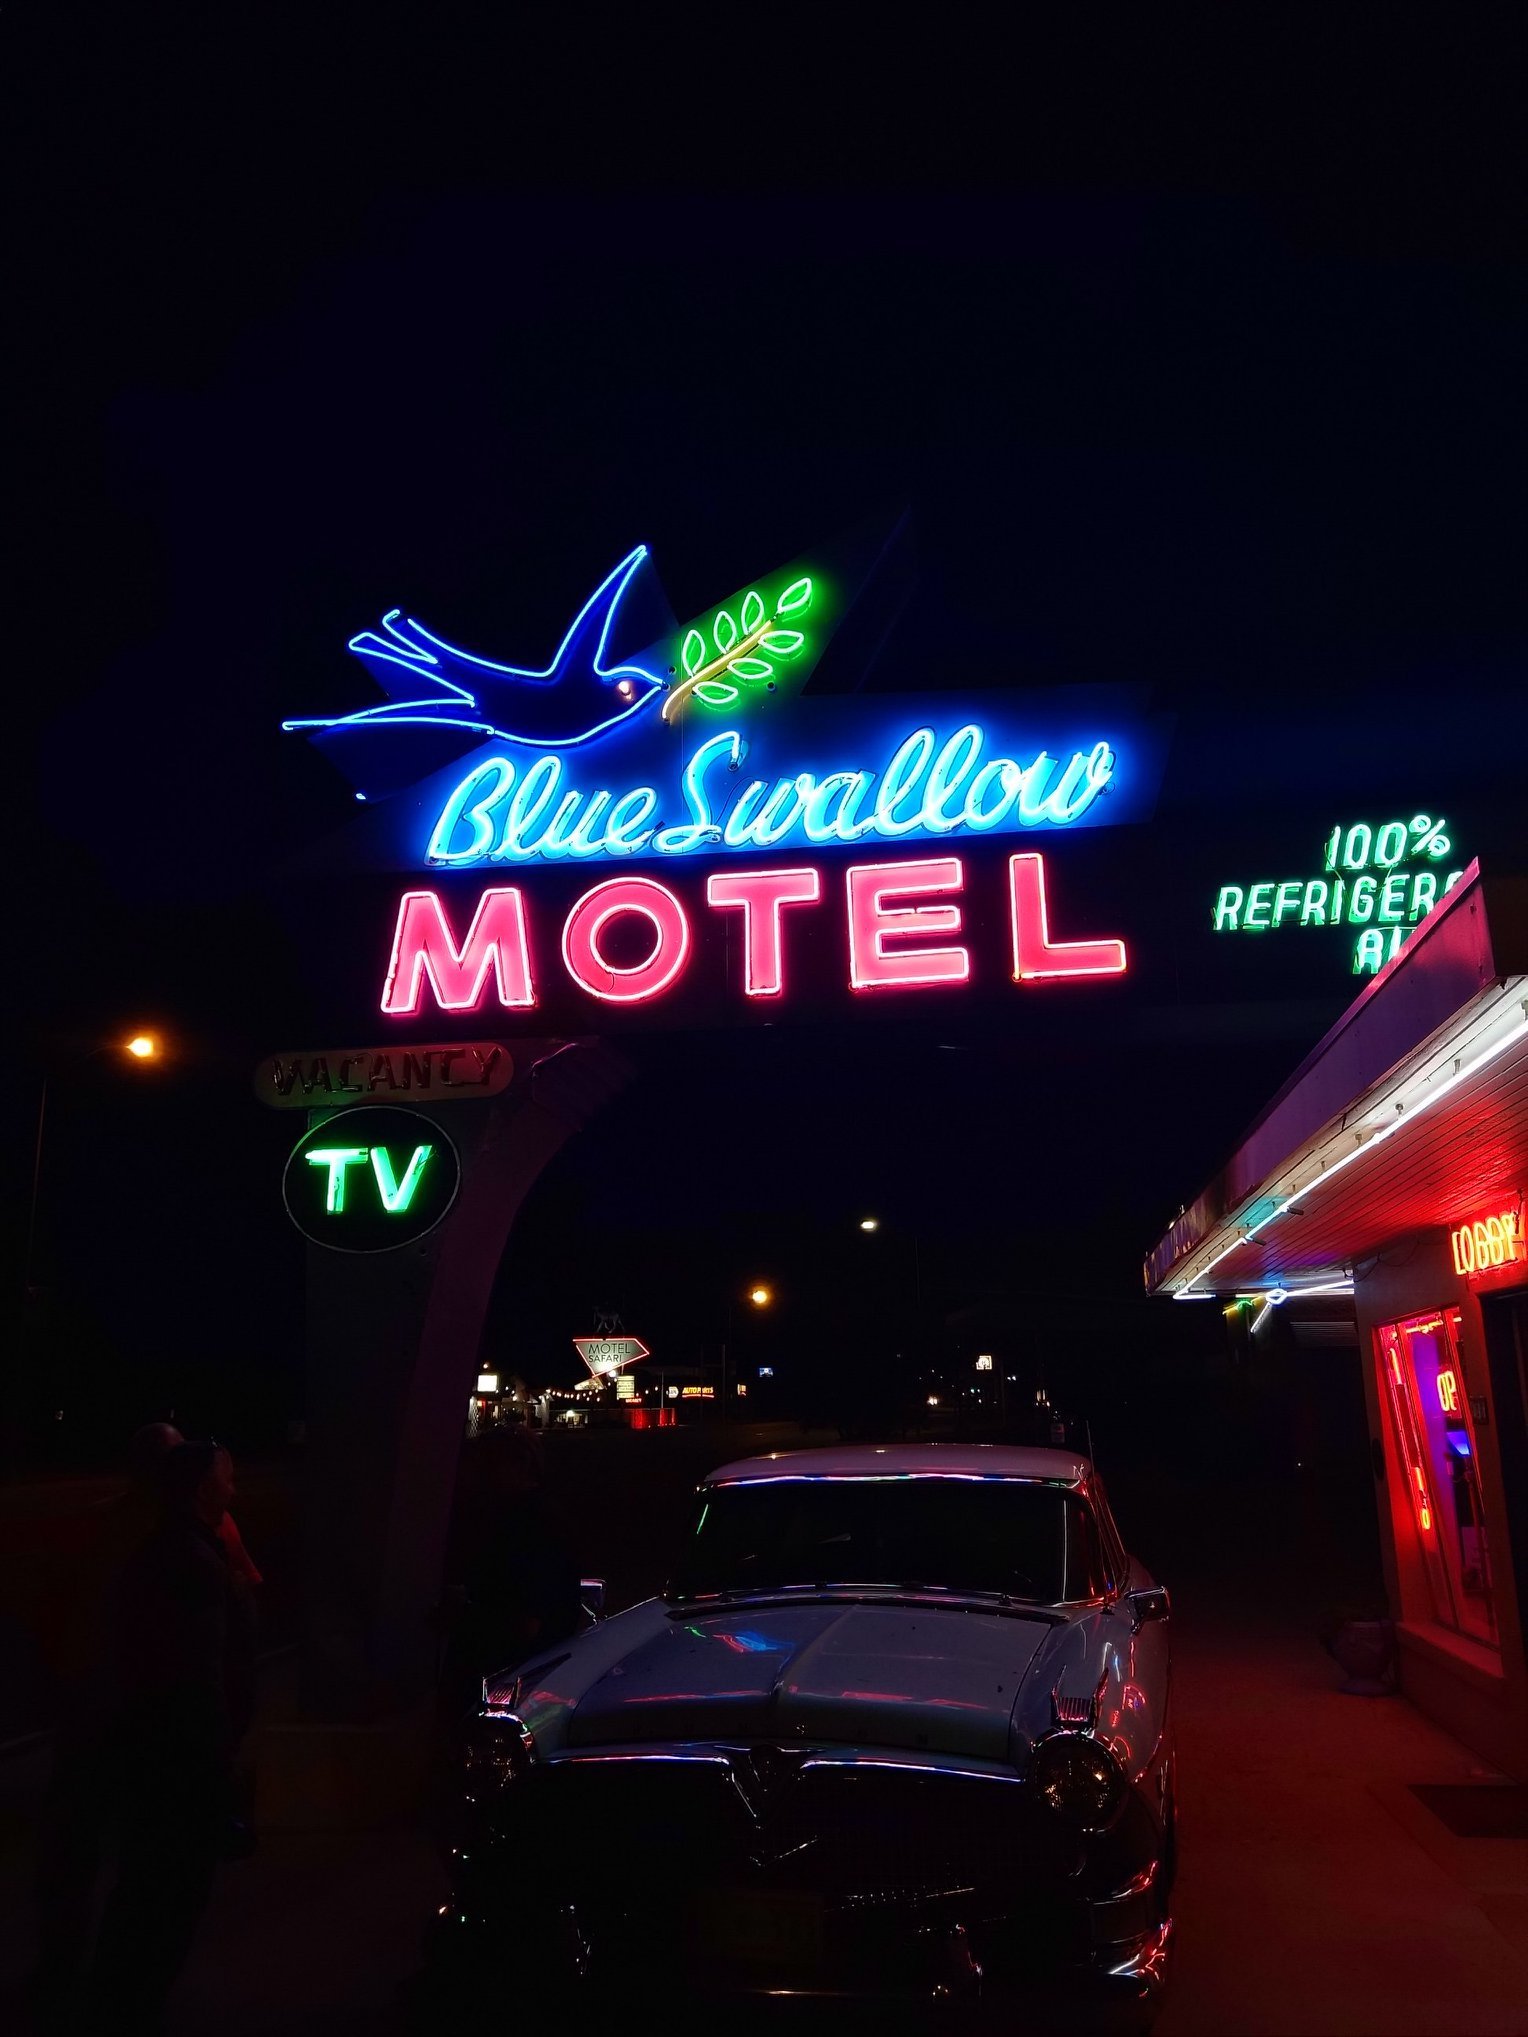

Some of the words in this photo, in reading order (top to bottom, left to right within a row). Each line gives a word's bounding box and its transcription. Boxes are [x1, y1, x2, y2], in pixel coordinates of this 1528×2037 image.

[425, 755, 657, 867] Blue
[653, 723, 1114, 856] Swallow
[1325, 813, 1452, 871] 100%
[380, 853, 1127, 1014] MOTEL
[272, 1045, 503, 1096] VACANCY
[304, 1145, 434, 1215] TV
[1451, 1211, 1518, 1276] LOBBY
[588, 1343, 631, 1354] MOTEL
[588, 1354, 623, 1363] SAFARI
[682, 1386, 697, 1394] AUTO
